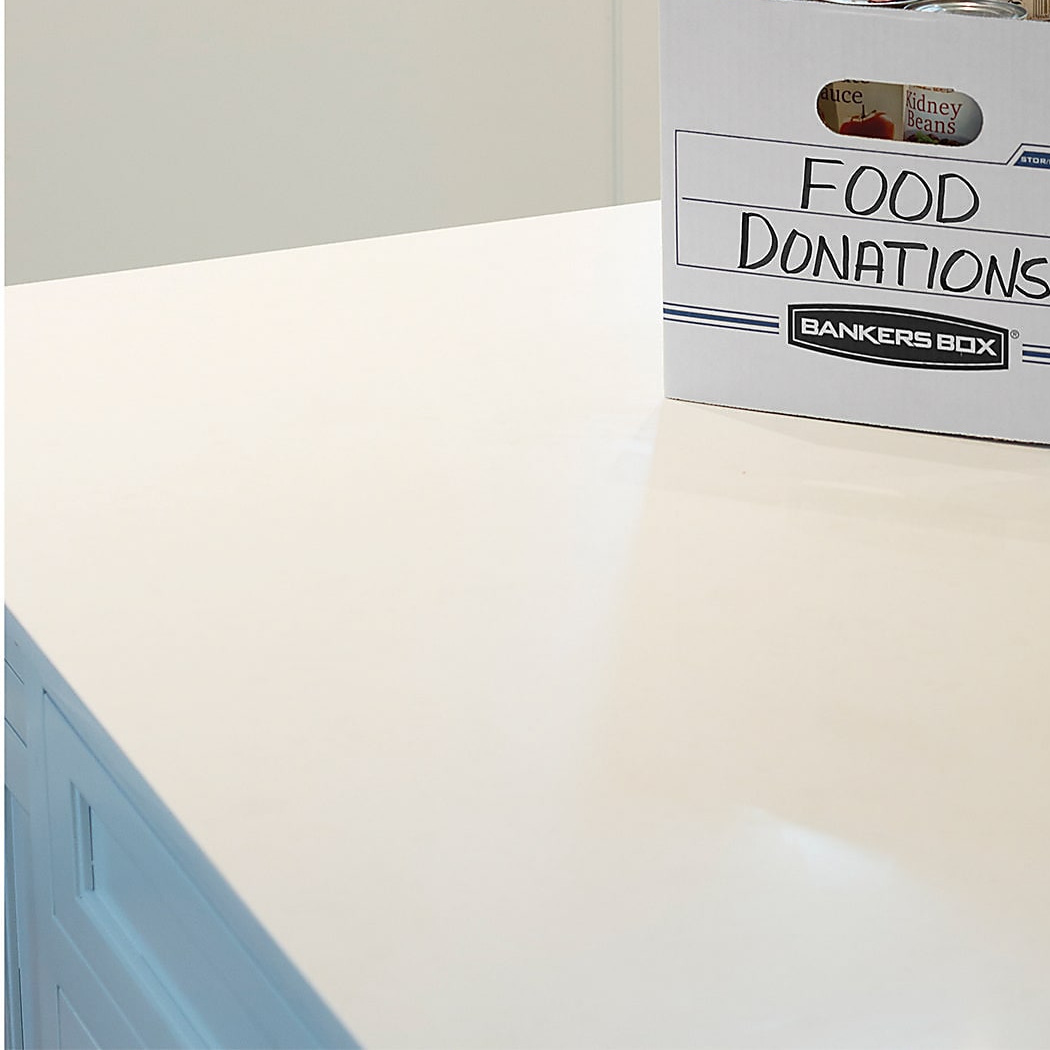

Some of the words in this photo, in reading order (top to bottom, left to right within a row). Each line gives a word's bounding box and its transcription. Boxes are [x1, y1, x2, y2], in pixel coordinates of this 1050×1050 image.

[820, 87, 863, 104] auce
[906, 89, 963, 120] Kidney
[907, 109, 957, 135] Beans
[800, 157, 979, 223] FOOD
[737, 211, 1050, 300] DONATIONS
[801, 317, 932, 349] BANKERS
[936, 333, 998, 357] BOX
